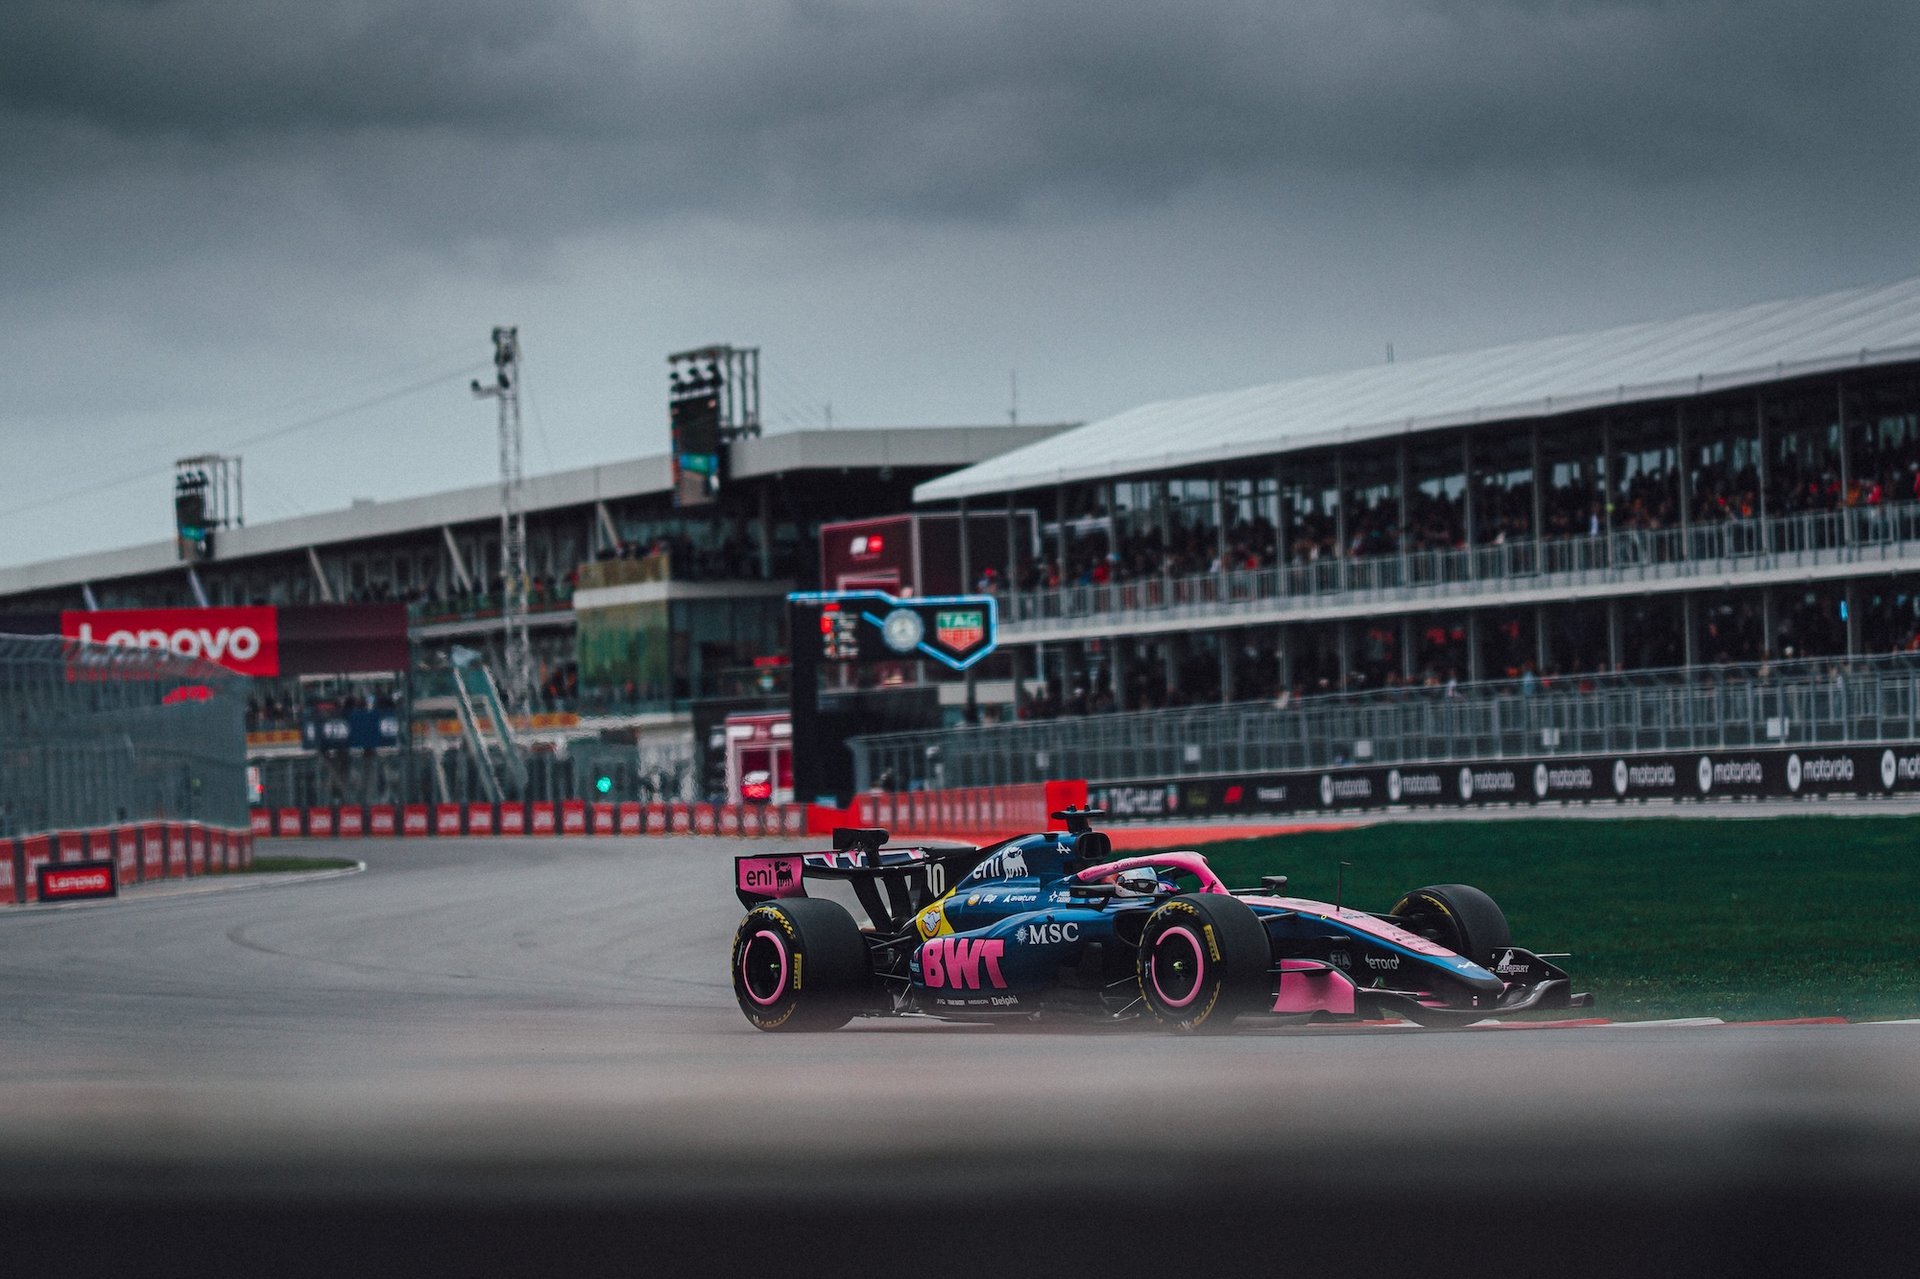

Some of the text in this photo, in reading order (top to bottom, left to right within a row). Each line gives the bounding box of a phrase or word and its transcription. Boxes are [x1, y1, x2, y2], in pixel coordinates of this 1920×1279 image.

[1550, 768, 1593, 789] motorola
[1629, 763, 1675, 786] motorola
[1714, 760, 1762, 783] motorola
[1803, 756, 1854, 781] motorola
[1473, 771, 1515, 792] motorola
[746, 863, 772, 886] eni
[972, 857, 1000, 879] eni
[925, 863, 945, 898] 10
[1029, 922, 1079, 945] MSC
[922, 938, 1008, 989] BWT
[991, 995, 1019, 1007] Delphi
